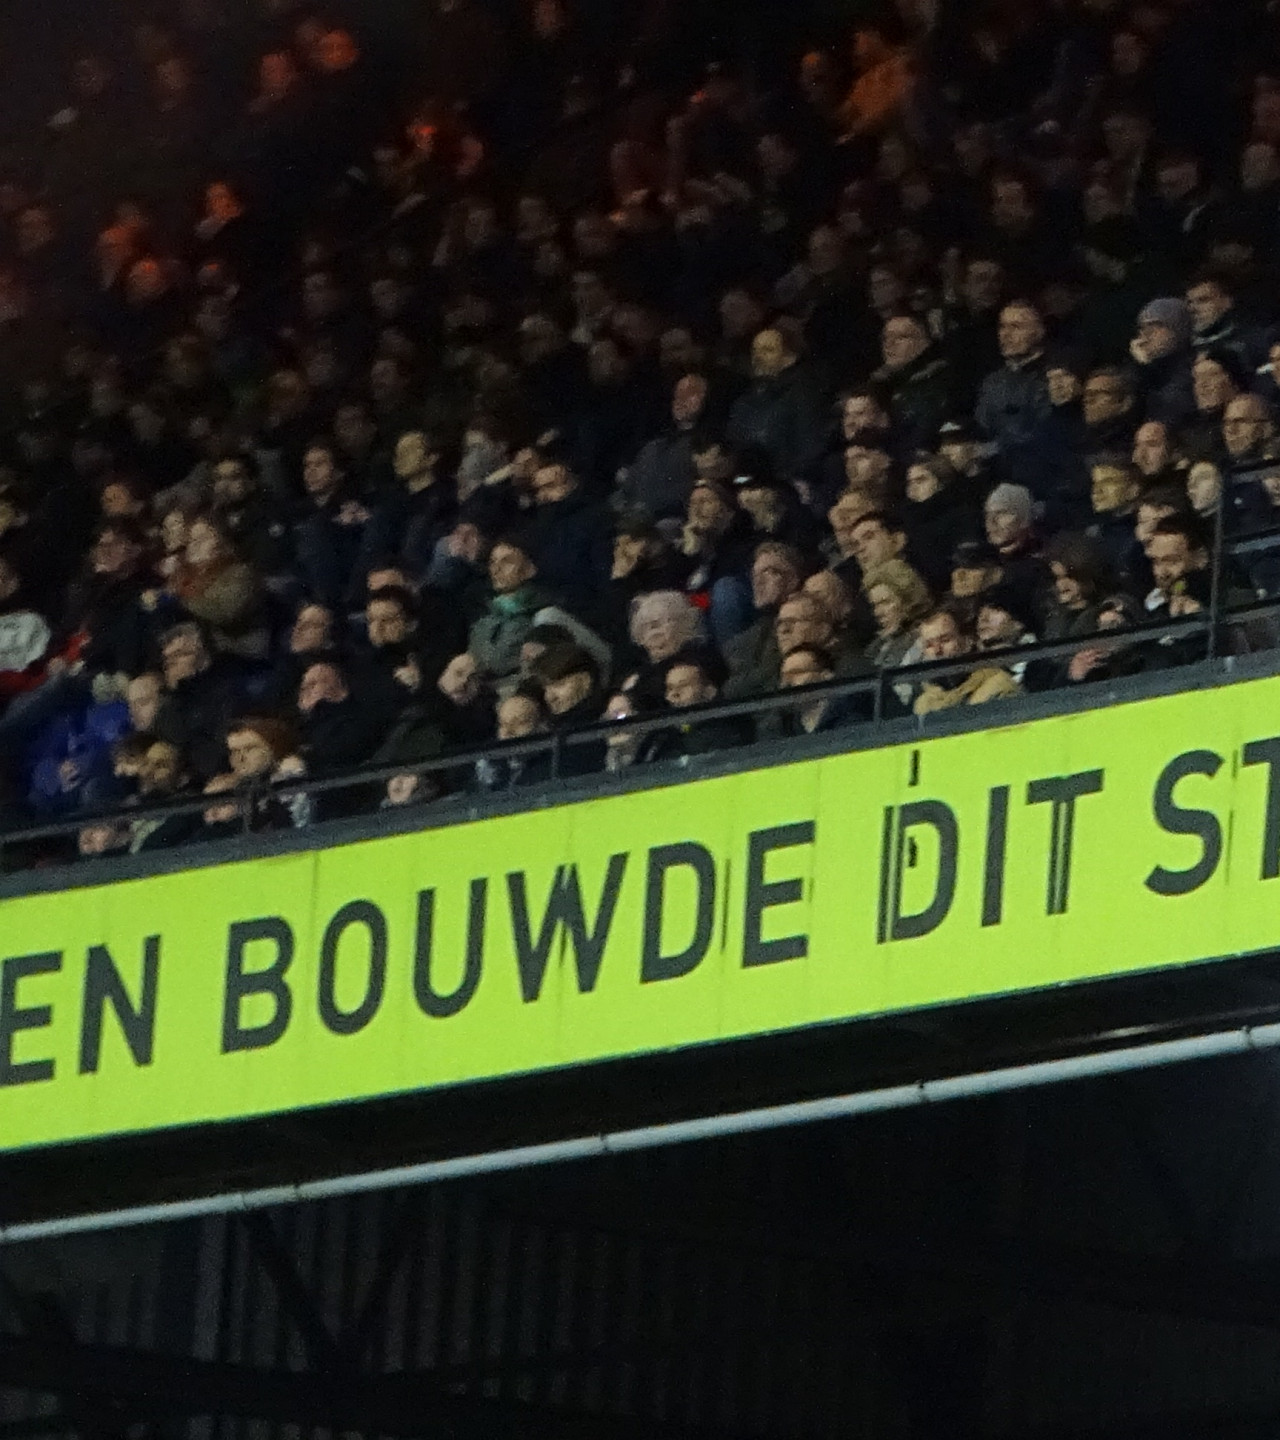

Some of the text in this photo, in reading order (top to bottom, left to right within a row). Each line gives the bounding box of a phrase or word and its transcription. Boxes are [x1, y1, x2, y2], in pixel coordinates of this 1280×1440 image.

[0, 935, 161, 1087] EN
[221, 821, 816, 1054] BOUWDE
[876, 769, 1104, 945] DIT
